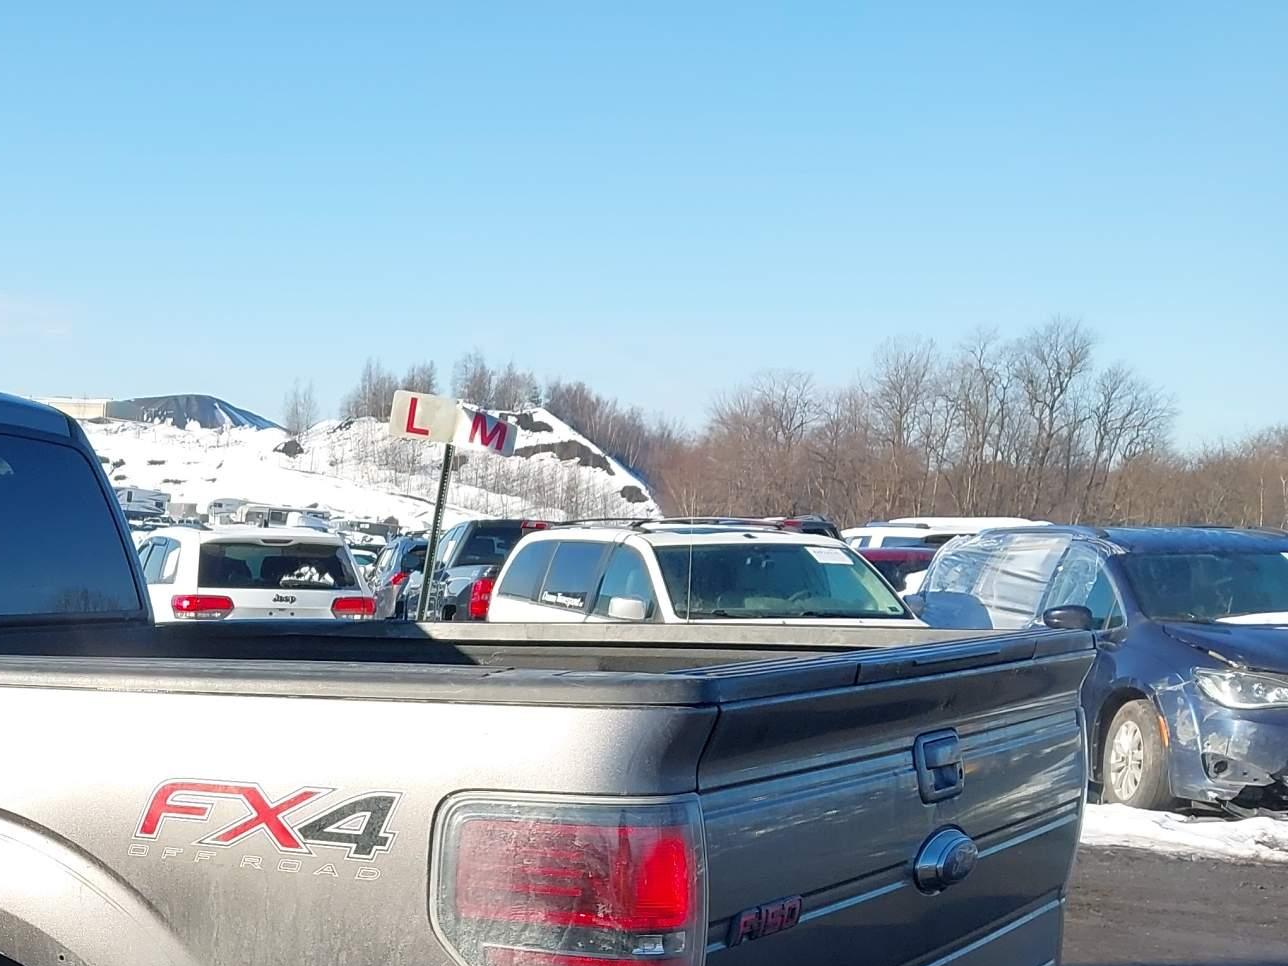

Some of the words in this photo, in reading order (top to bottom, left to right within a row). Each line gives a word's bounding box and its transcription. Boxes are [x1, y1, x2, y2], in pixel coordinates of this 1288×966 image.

[405, 397, 430, 436] L
[468, 410, 508, 452] M
[272, 593, 297, 605] Jeep
[132, 778, 407, 863] FX4
[127, 843, 217, 866] OFF
[240, 854, 382, 881] ROAD
